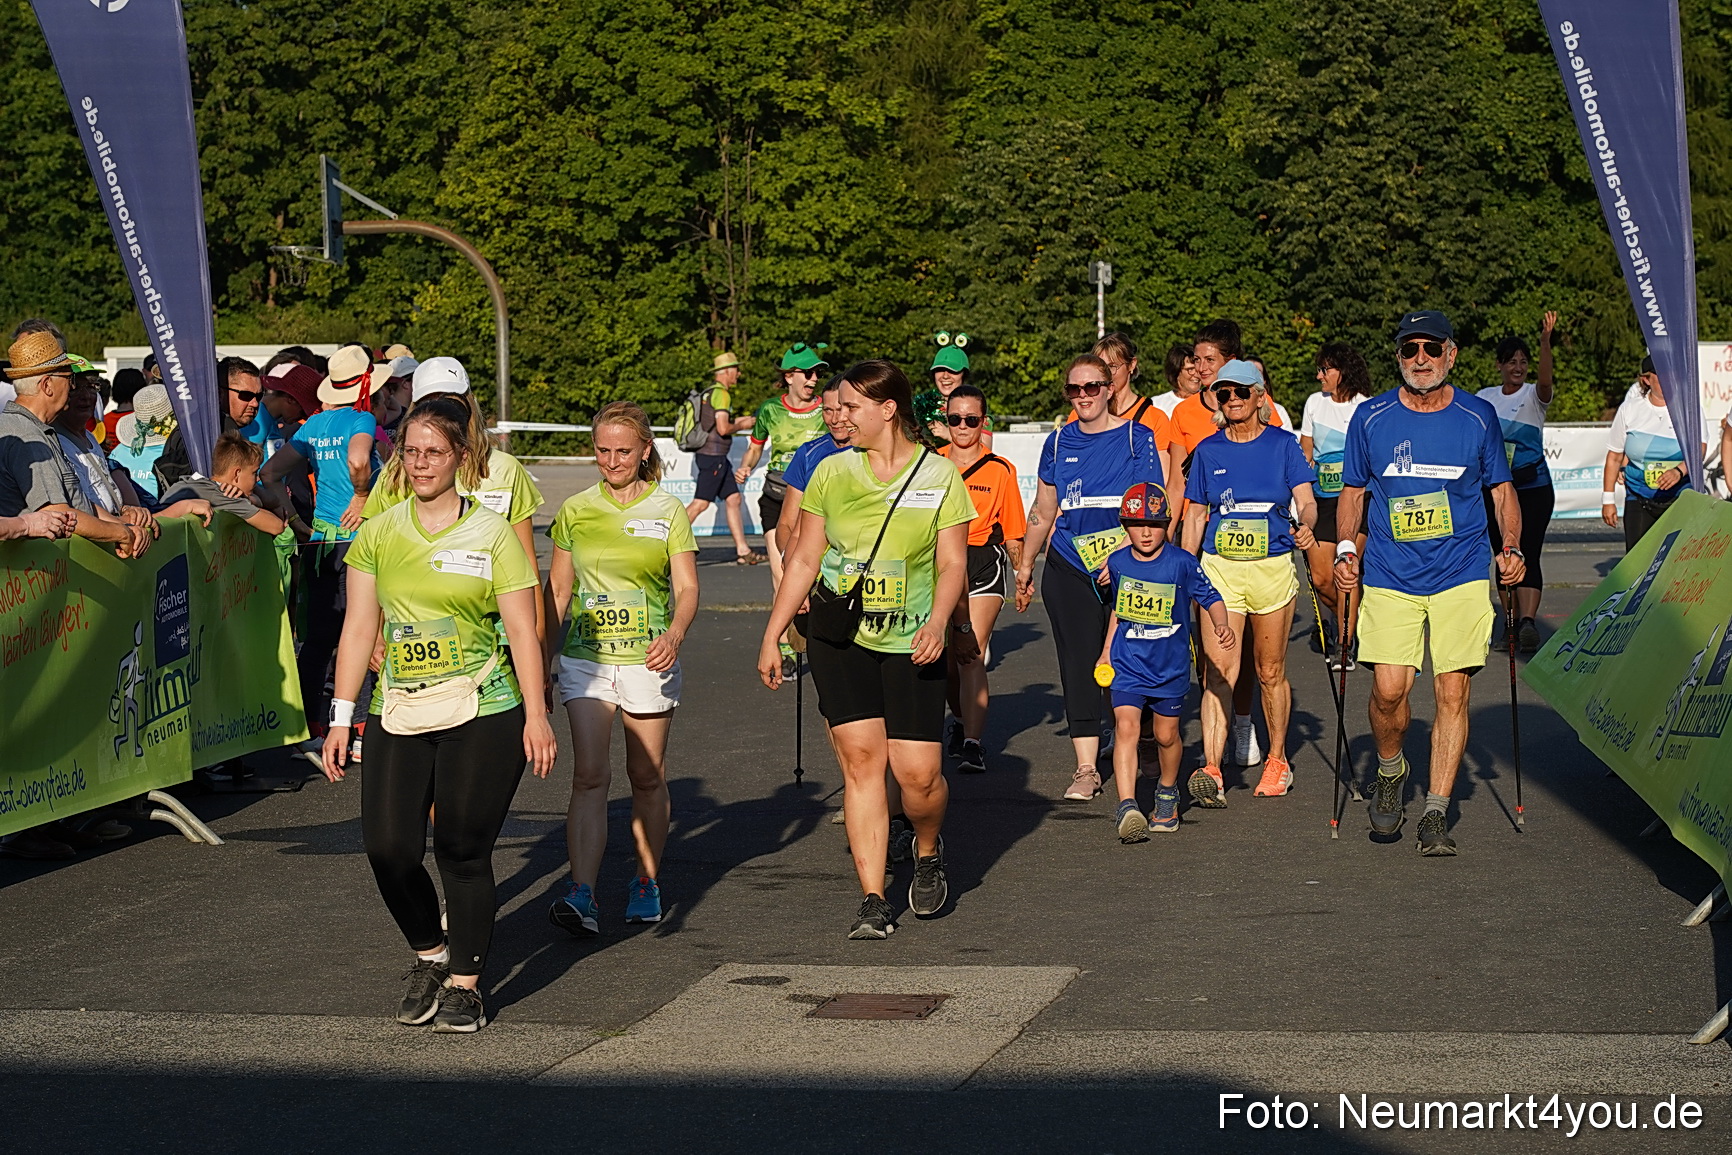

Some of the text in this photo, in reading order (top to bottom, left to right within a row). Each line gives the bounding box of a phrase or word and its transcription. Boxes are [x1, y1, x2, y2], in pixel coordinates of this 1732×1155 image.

[1323, 472, 1342, 483] 120
[968, 485, 992, 494] THULE
[1393, 515, 1401, 537] WALK
[1404, 509, 1435, 527] 787
[1442, 509, 1450, 530] 2022
[1401, 523, 1443, 534] Schüßler Erich
[1227, 533, 1255, 547] 790
[1081, 548, 1093, 567] WALK
[24, 559, 69, 601] Firmen
[862, 577, 886, 595] 01
[158, 589, 188, 615] Fischer
[1126, 593, 1163, 612] 1341
[1164, 601, 1172, 620] 2022
[161, 605, 188, 624] AUTOMOBILE
[595, 608, 630, 627] 399
[637, 609, 645, 634] 2022
[1128, 608, 1146, 616] Brandl
[2, 587, 89, 669] laufen länger!
[392, 646, 400, 675] WALK
[403, 640, 441, 663] 398
[448, 639, 460, 667] 2022
[400, 660, 450, 672] Grebner Tanja
